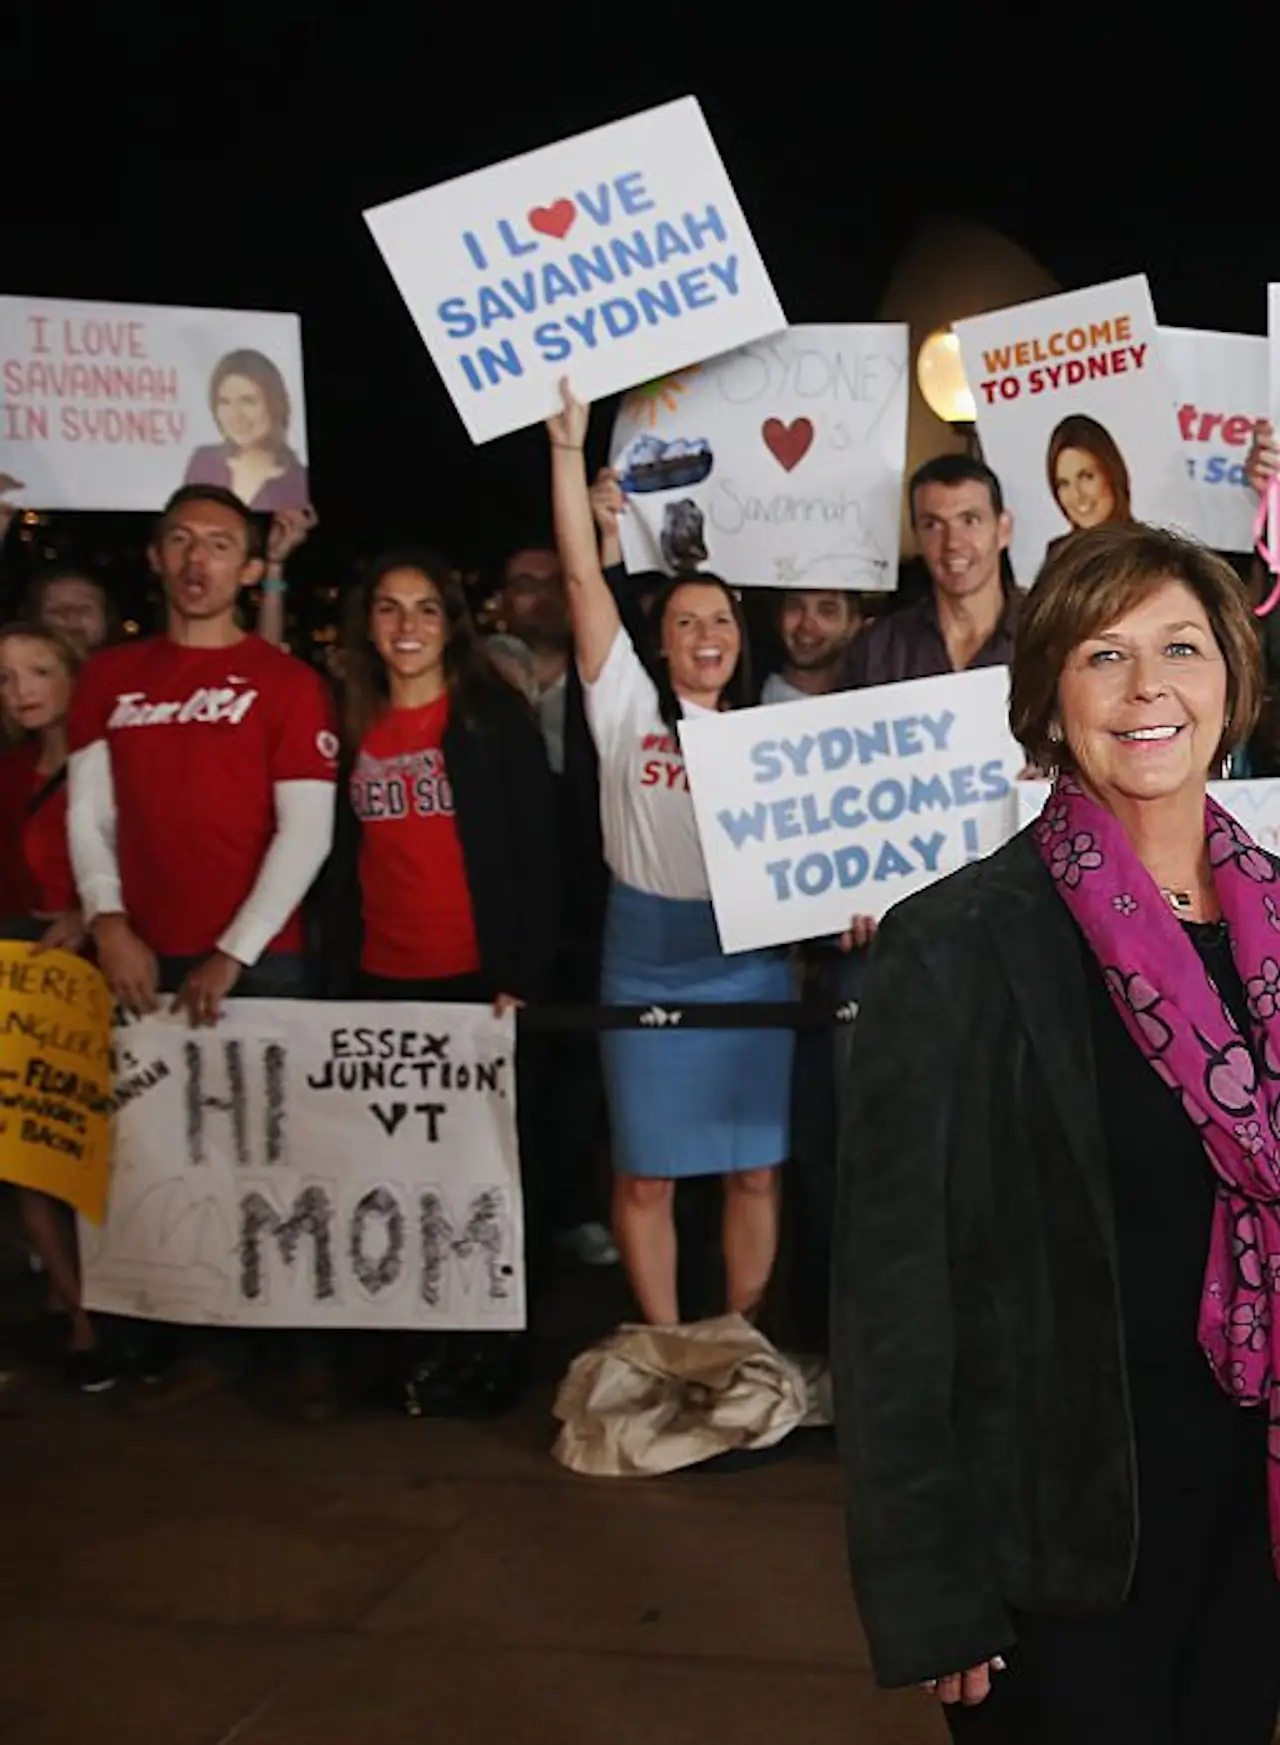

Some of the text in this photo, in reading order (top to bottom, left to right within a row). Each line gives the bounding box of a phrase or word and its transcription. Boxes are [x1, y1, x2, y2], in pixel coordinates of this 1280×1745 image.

[438, 205, 728, 338] SAVANNAH
[462, 231, 488, 270] I
[28, 316, 147, 358] I LOVE
[458, 255, 740, 392] IN SYDNEY
[982, 316, 1131, 374] WELCOME
[3, 361, 179, 400] SAVANNAH
[981, 343, 1148, 405] TO SYDNEY
[5, 404, 188, 444] IN SYDNEY
[640, 760, 691, 793] SY
[750, 710, 957, 783] SYDNEY
[717, 760, 1012, 849] WELCOMES
[183, 1029, 451, 1164] HI ESSEX
[307, 1061, 497, 1090] JUNCTION
[234, 1181, 505, 1305] MOM
